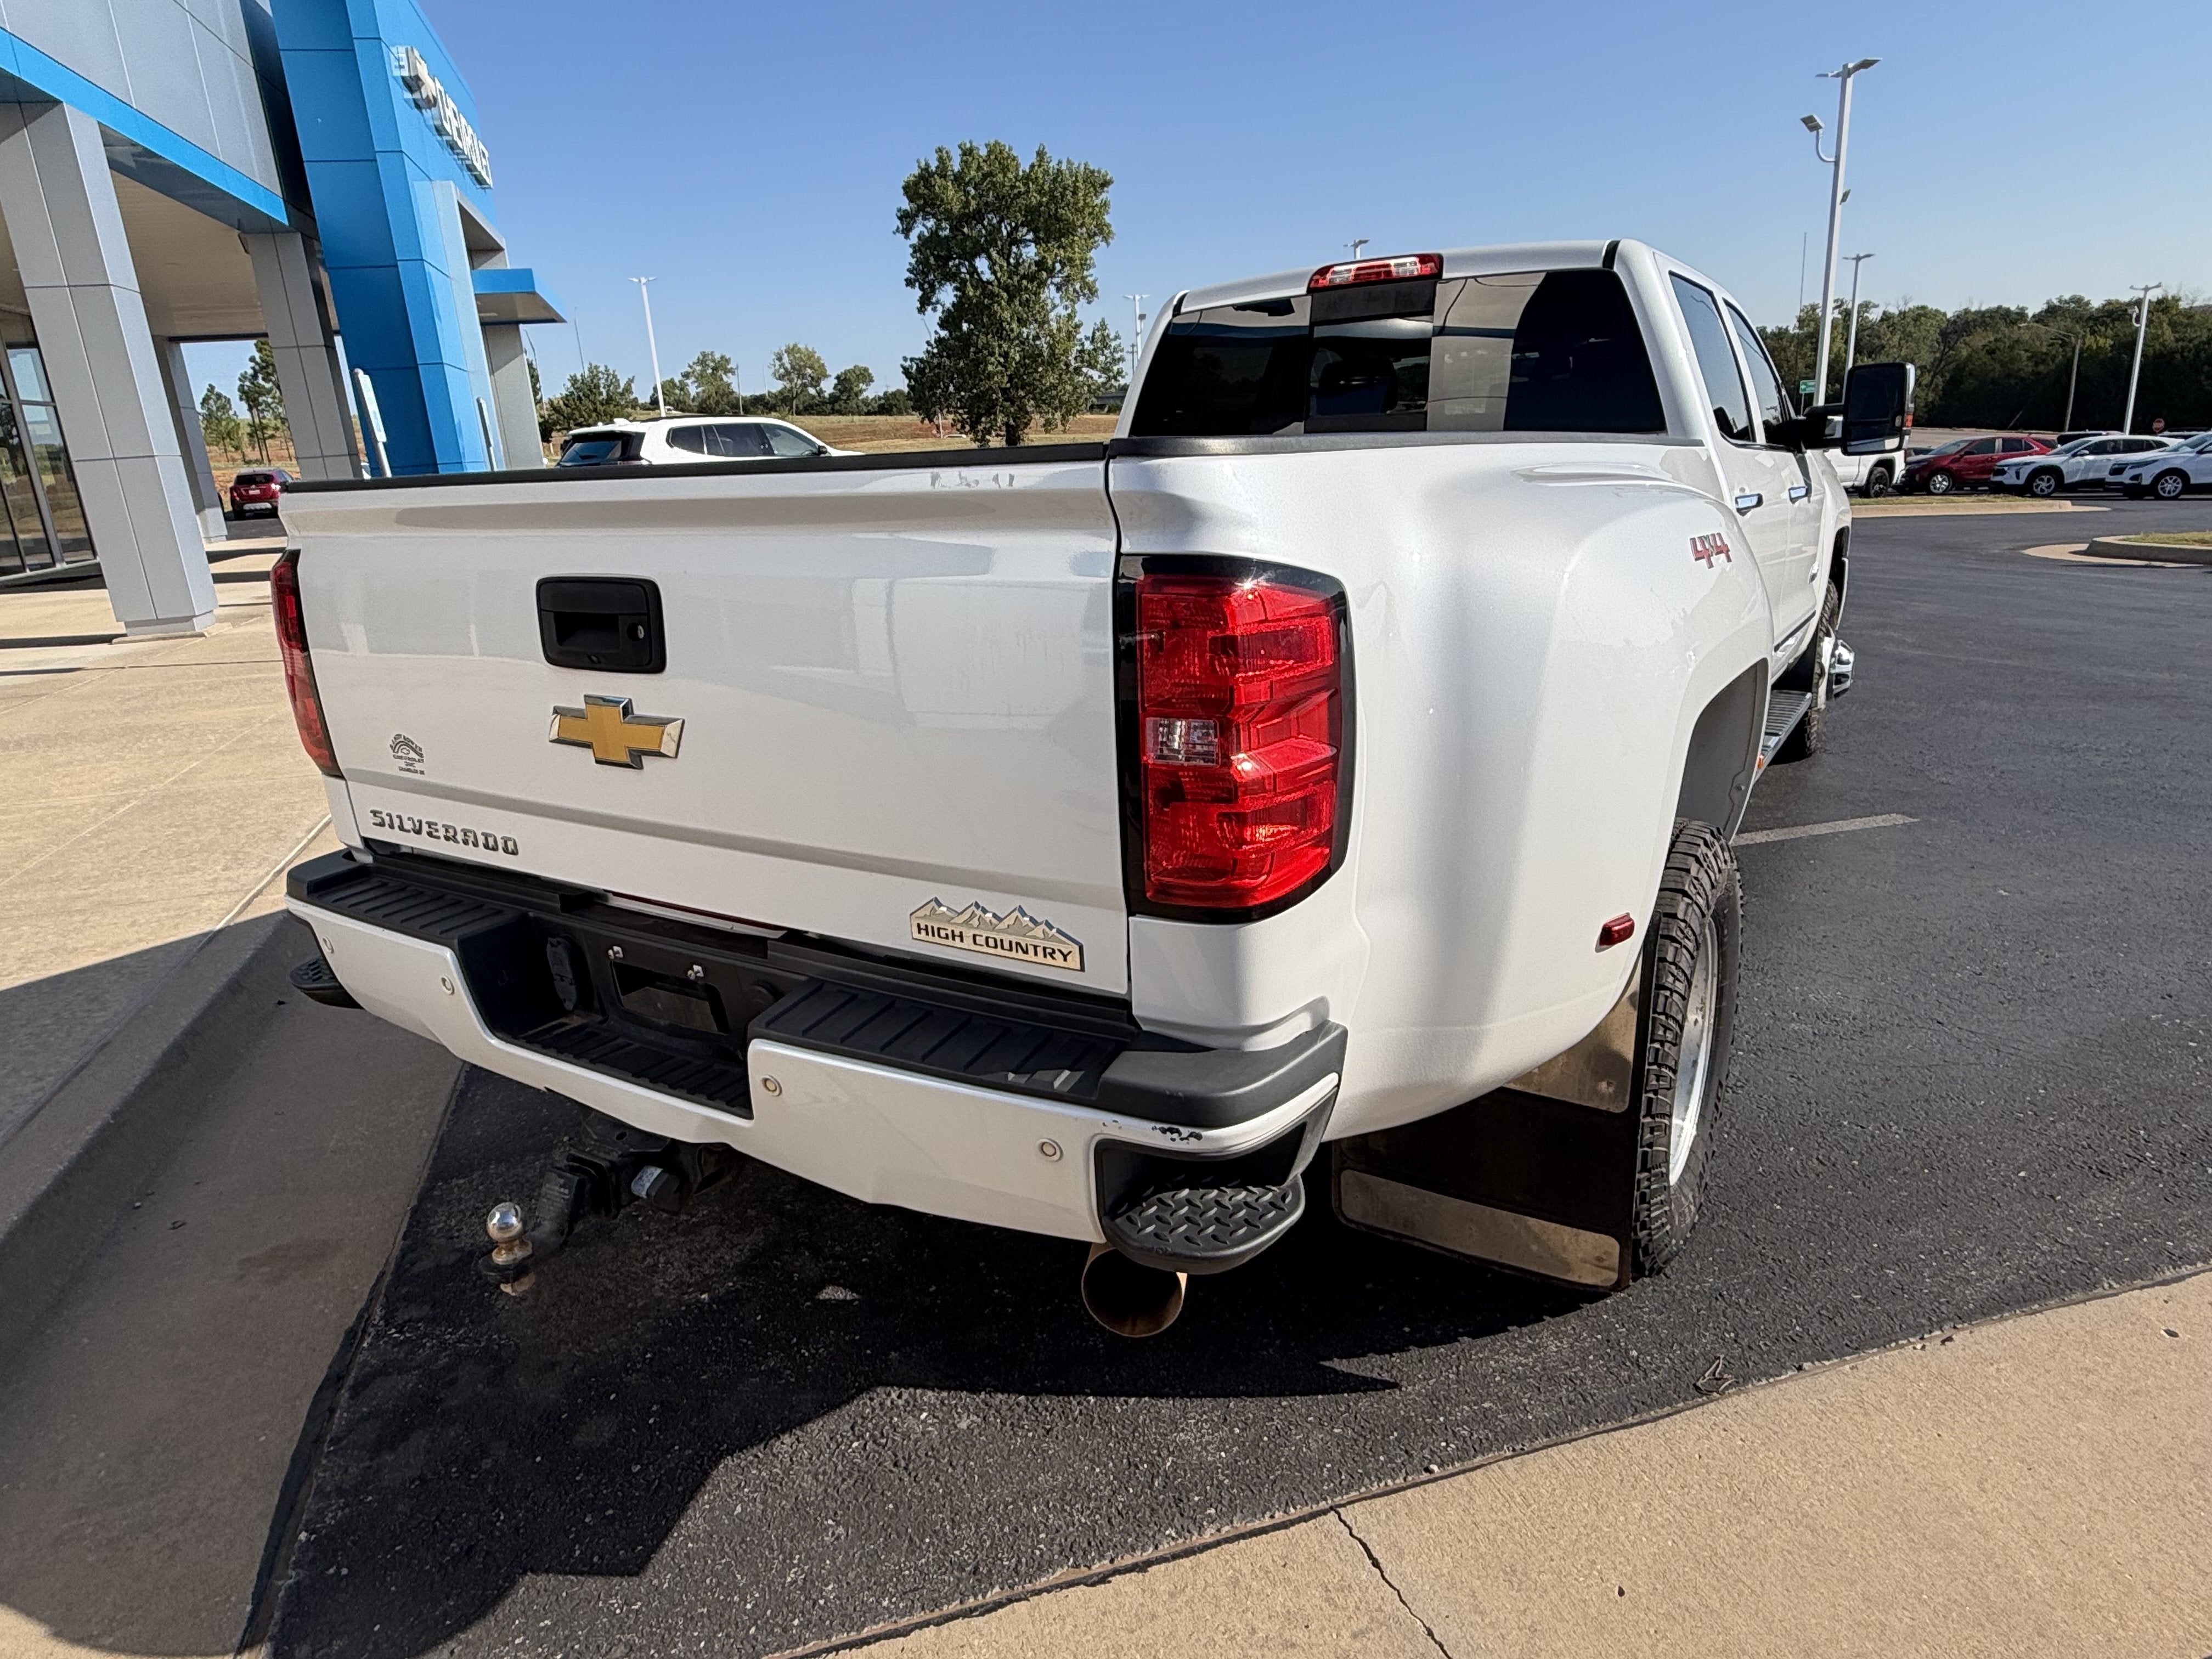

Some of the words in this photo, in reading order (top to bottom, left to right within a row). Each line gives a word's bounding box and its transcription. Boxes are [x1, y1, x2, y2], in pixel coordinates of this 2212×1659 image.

[369, 809, 520, 855] SILVERADO
[916, 922, 964, 943] HIGH
[972, 933, 1073, 962] COUNTRY
